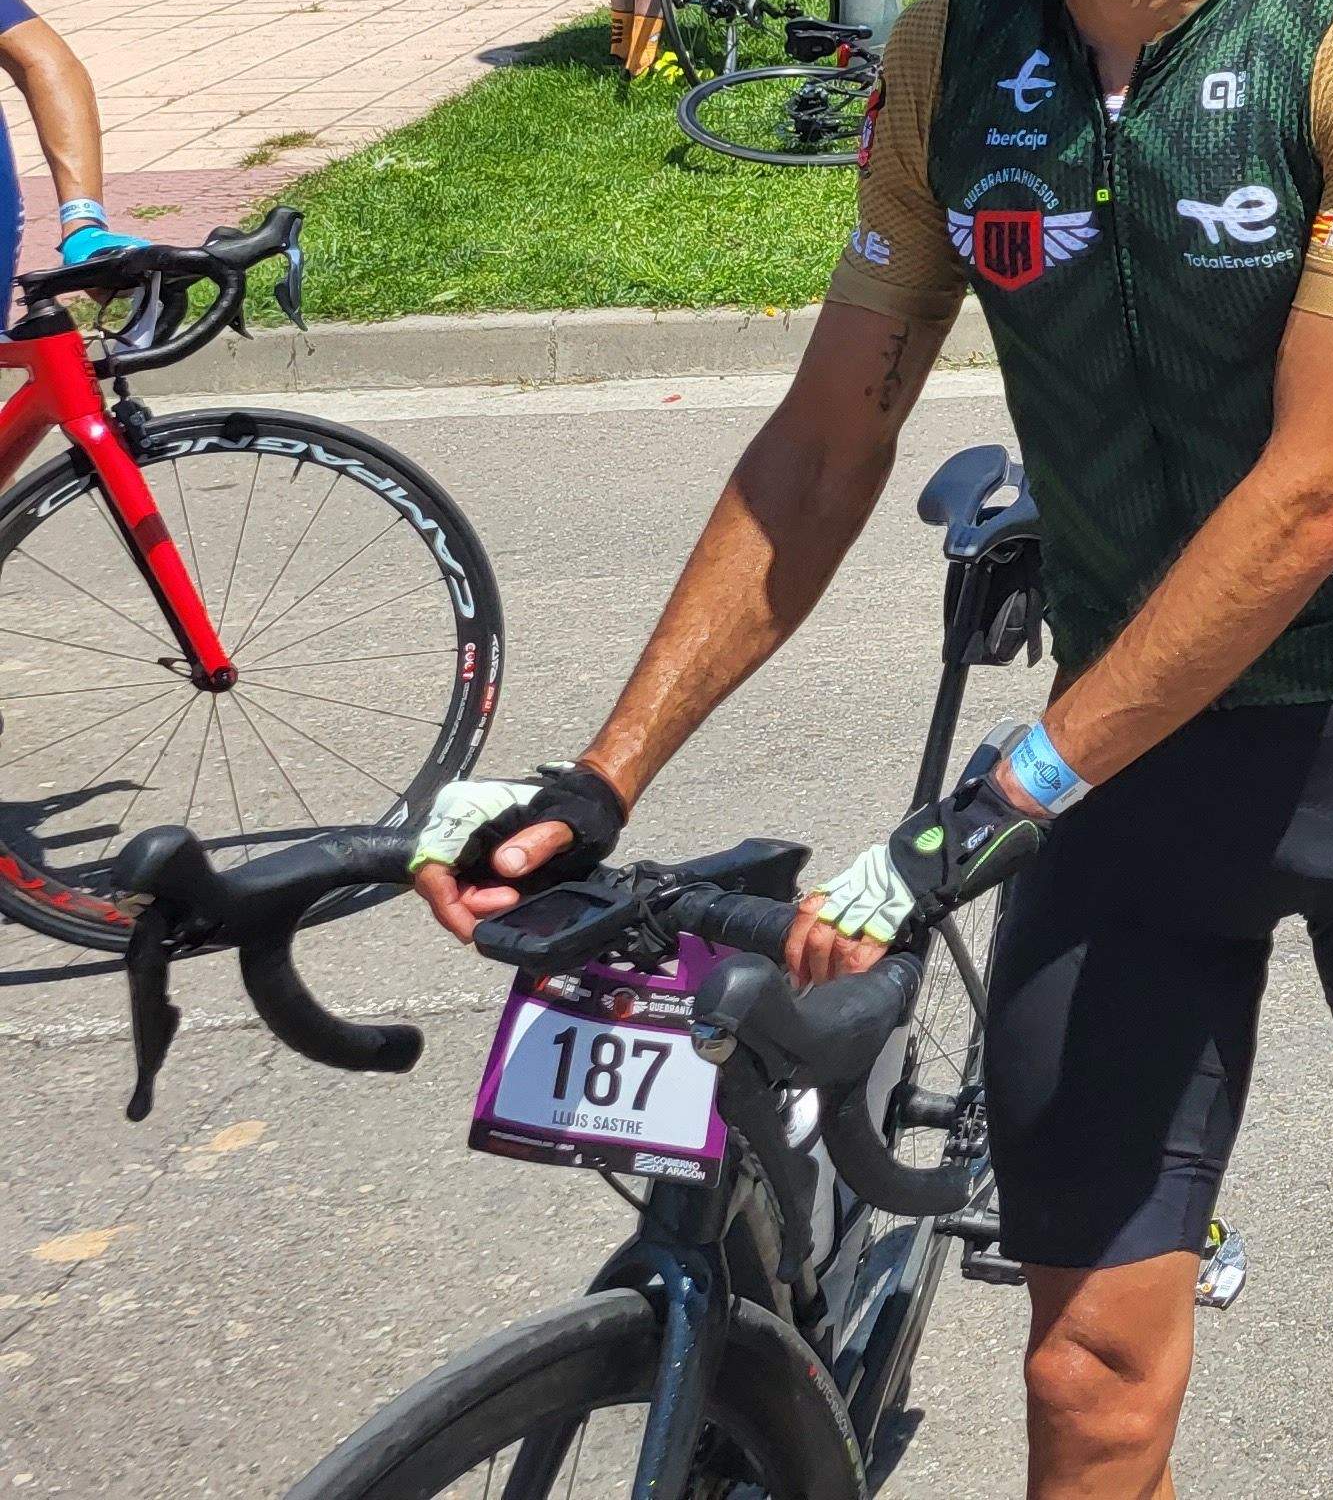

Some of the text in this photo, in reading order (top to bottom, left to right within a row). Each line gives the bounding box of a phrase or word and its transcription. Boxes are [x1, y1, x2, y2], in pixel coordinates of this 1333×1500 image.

[985, 128, 1048, 150] iberCaja
[963, 167, 1061, 211] QUEBRANTAHUESOS
[1183, 248, 1295, 270] TotalEnergies
[552, 1025, 674, 1112] 187
[551, 1109, 644, 1135] LLUIS SASTRE
[652, 1164, 667, 1174] DE
[653, 1155, 701, 1170] GOBIERNO
